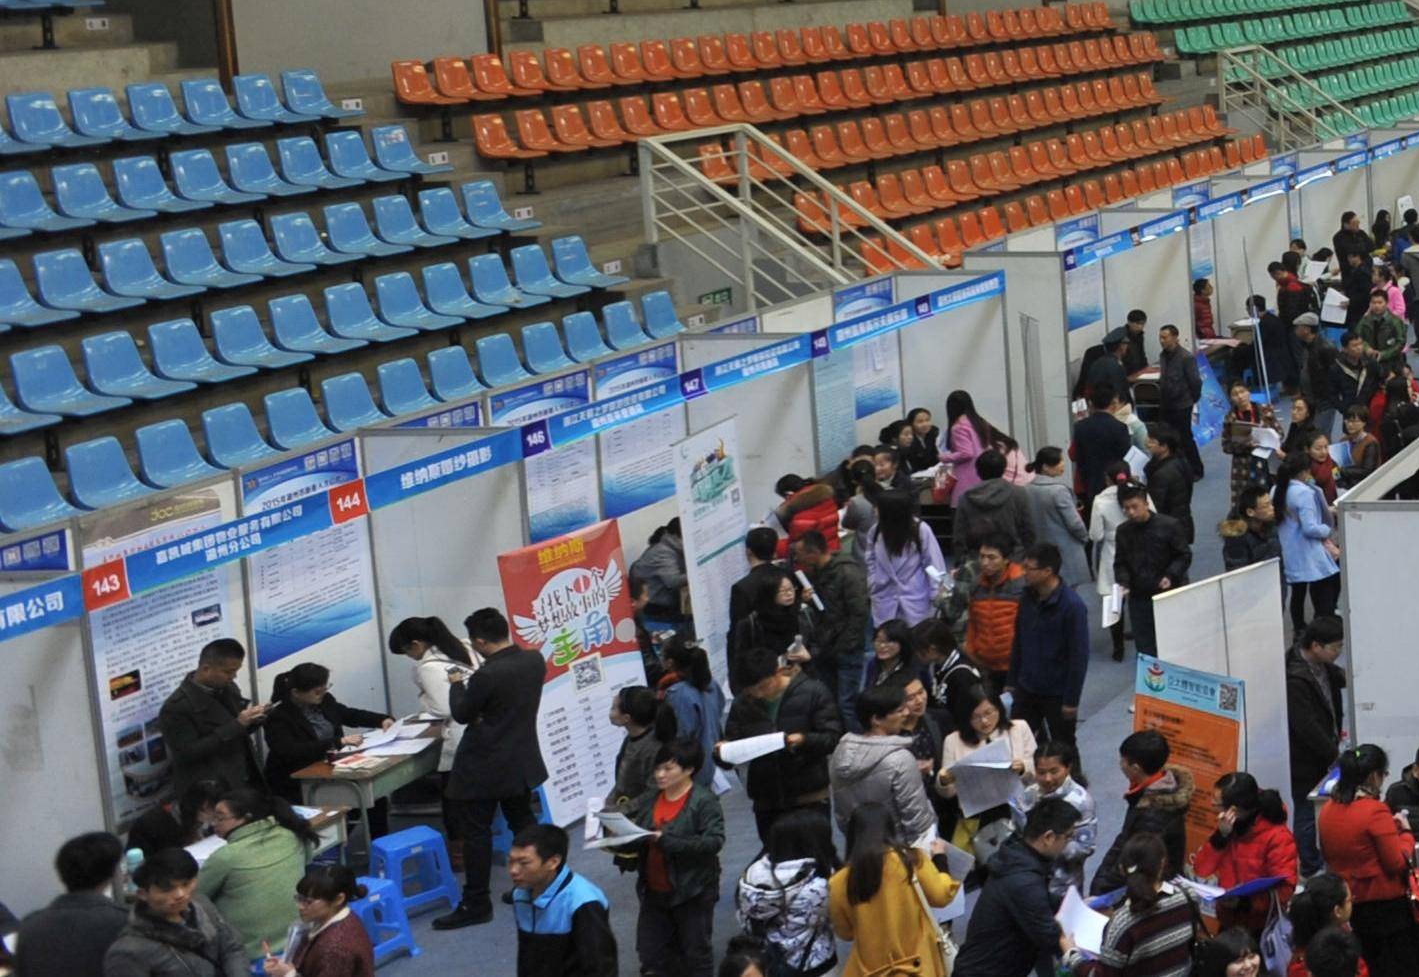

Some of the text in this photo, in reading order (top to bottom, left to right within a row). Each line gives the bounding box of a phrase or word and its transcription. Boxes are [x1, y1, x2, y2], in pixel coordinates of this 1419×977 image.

[526, 430, 545, 448] 146
[336, 494, 362, 513] 144
[92, 576, 121, 597] 143
[0, 590, 65, 629] 限公司
